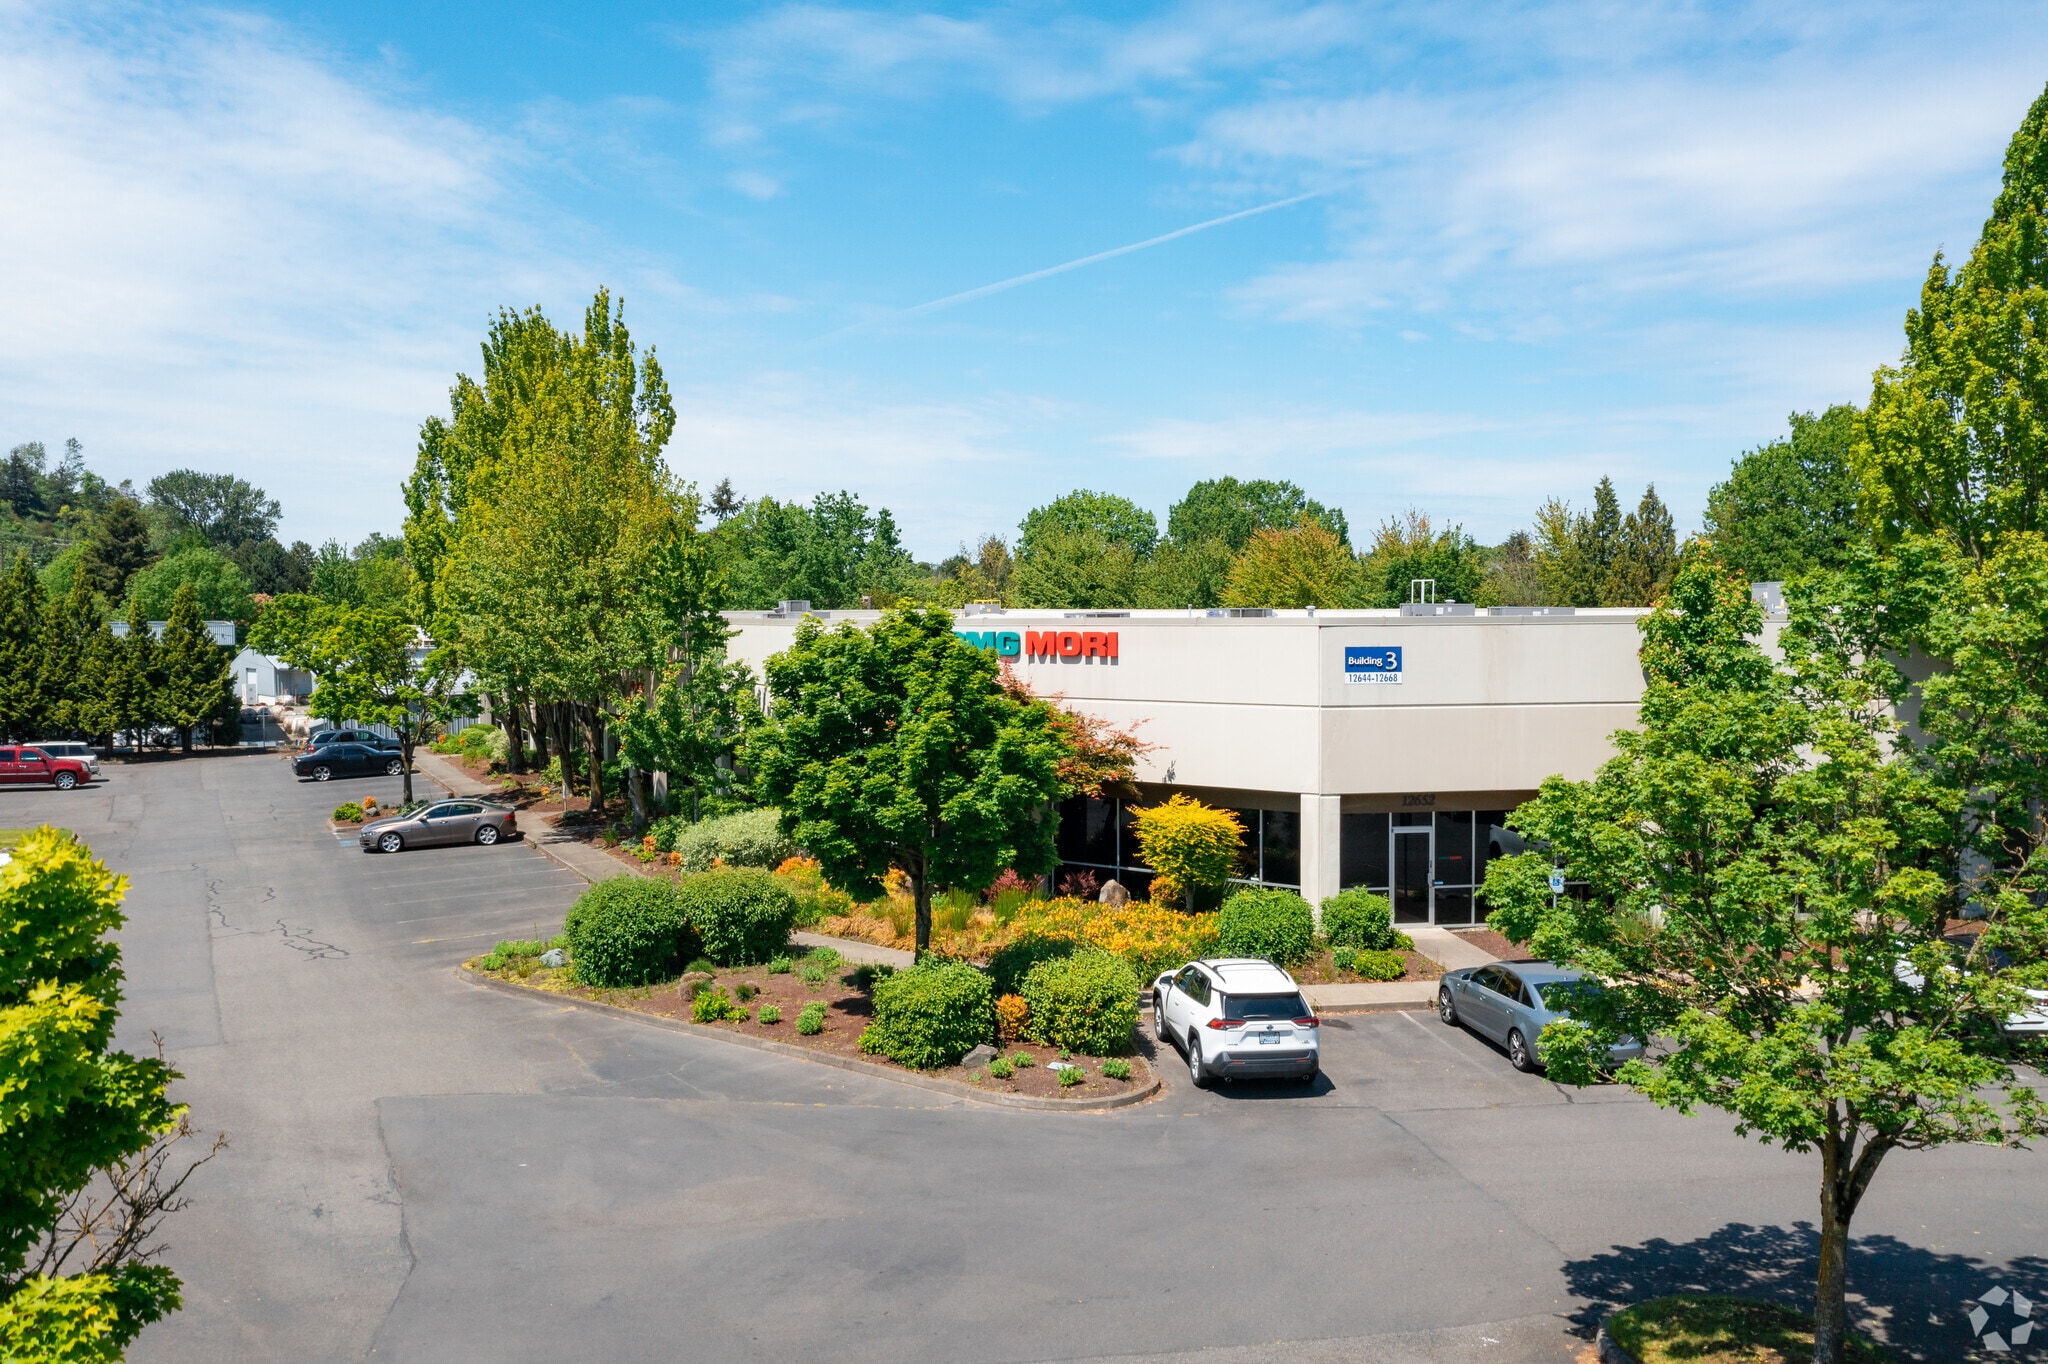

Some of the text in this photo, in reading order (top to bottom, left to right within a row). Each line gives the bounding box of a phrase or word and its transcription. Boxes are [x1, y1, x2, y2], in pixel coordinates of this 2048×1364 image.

[954, 631, 1119, 657] MG MORI
[1348, 651, 1398, 670] Building 3
[1349, 673, 1398, 683] 12644-12668
[1401, 793, 1436, 806] 12652
